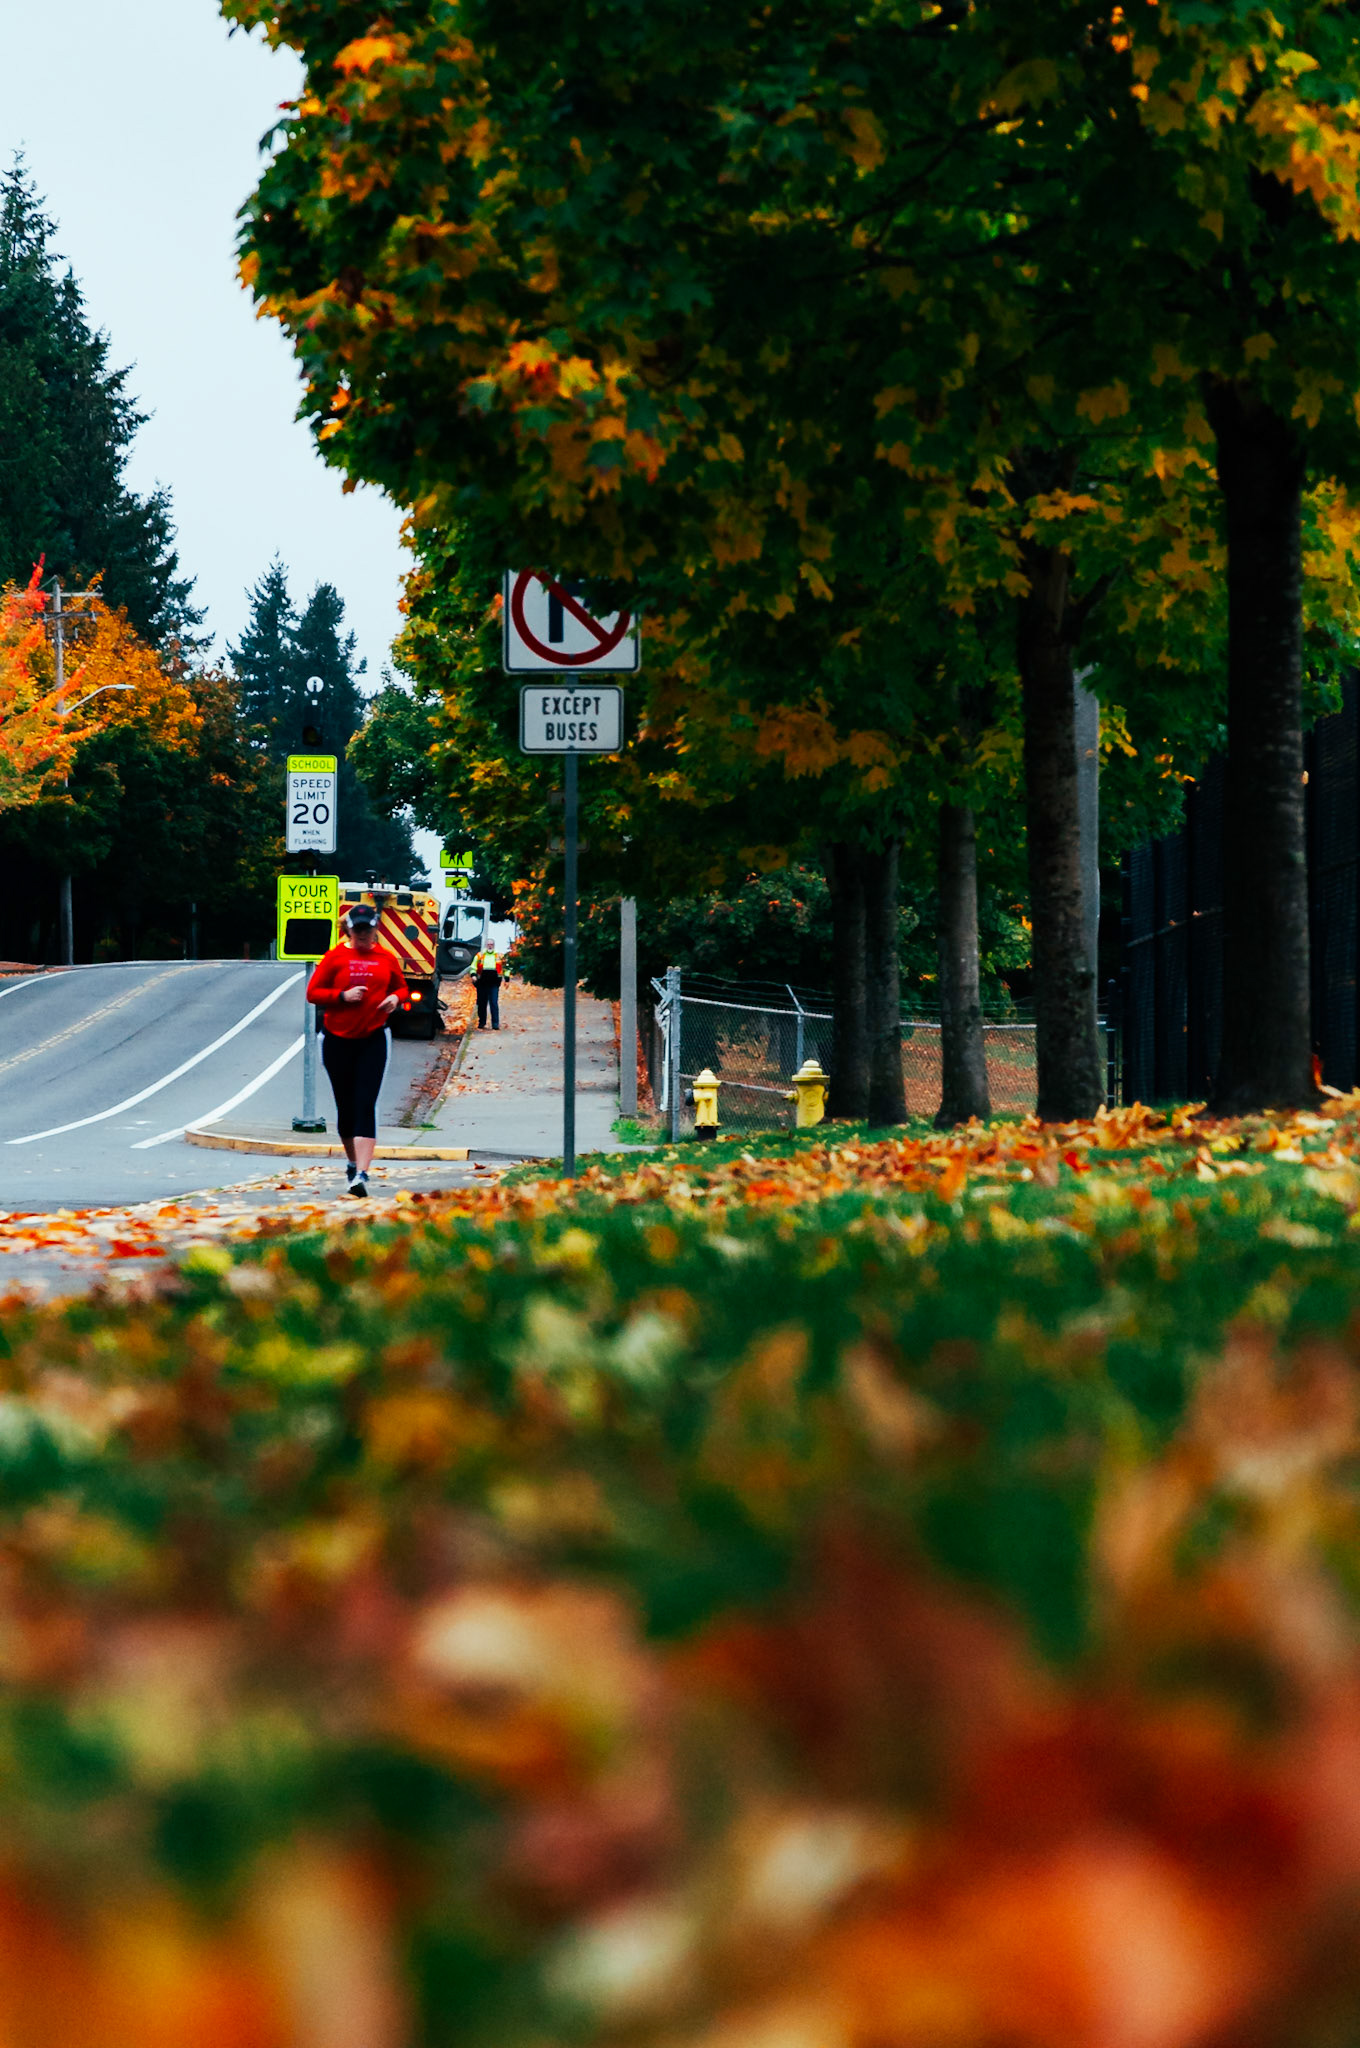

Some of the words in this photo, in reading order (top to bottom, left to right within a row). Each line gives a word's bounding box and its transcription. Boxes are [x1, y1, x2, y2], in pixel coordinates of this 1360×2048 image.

[541, 697, 601, 715] EXCEPT
[545, 723, 598, 741] BUSES
[291, 760, 332, 769] SCHOOL
[292, 779, 331, 788] SPEED
[296, 791, 327, 800] LIMIT
[292, 803, 330, 824] 20
[288, 884, 328, 898] YOUR
[284, 901, 333, 914] SPEED
